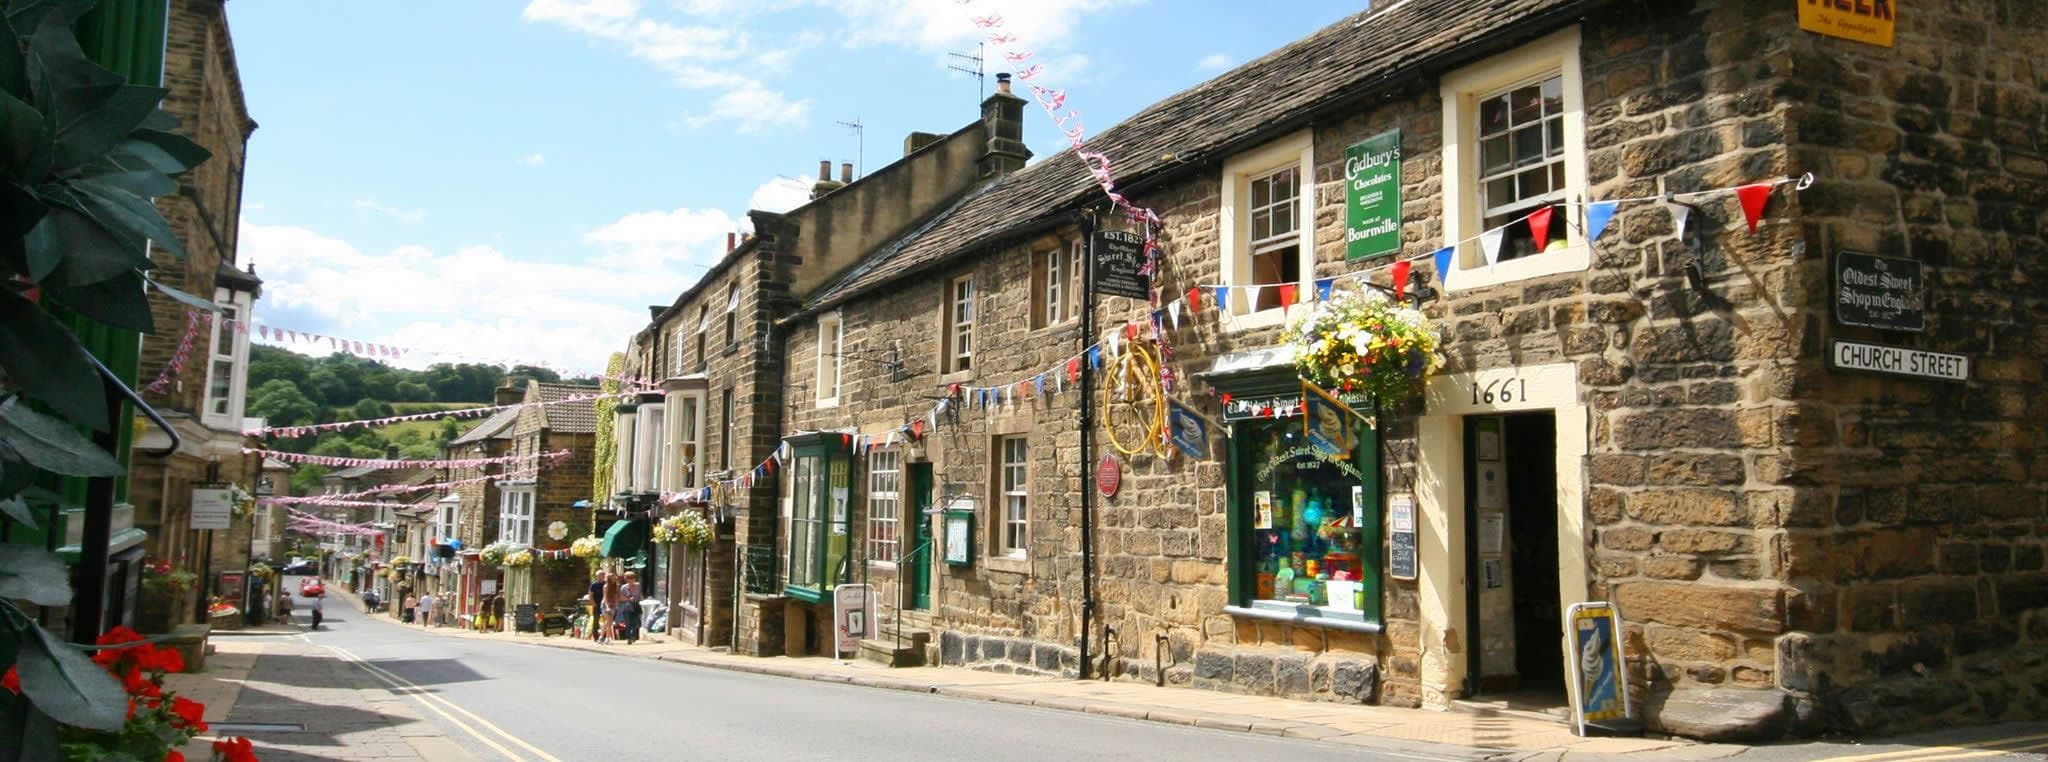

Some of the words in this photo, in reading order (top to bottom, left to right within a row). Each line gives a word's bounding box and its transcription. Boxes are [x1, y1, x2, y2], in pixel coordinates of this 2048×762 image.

[1345, 145, 1400, 180] Cadbury's
[1354, 172, 1392, 191] Chocolates
[1104, 231, 1122, 241] EST.
[1348, 217, 1397, 242] Bournville
[1843, 267, 1878, 286] Oldest
[1880, 271, 1913, 291] Sweet
[1840, 286, 1871, 310] Shop
[1841, 345, 1902, 370] CHURCH
[1910, 352, 1962, 377] STREET
[1273, 396, 1298, 409] Sweet
[1472, 378, 1526, 405] 1661
[1289, 445, 1311, 458] Sweet
